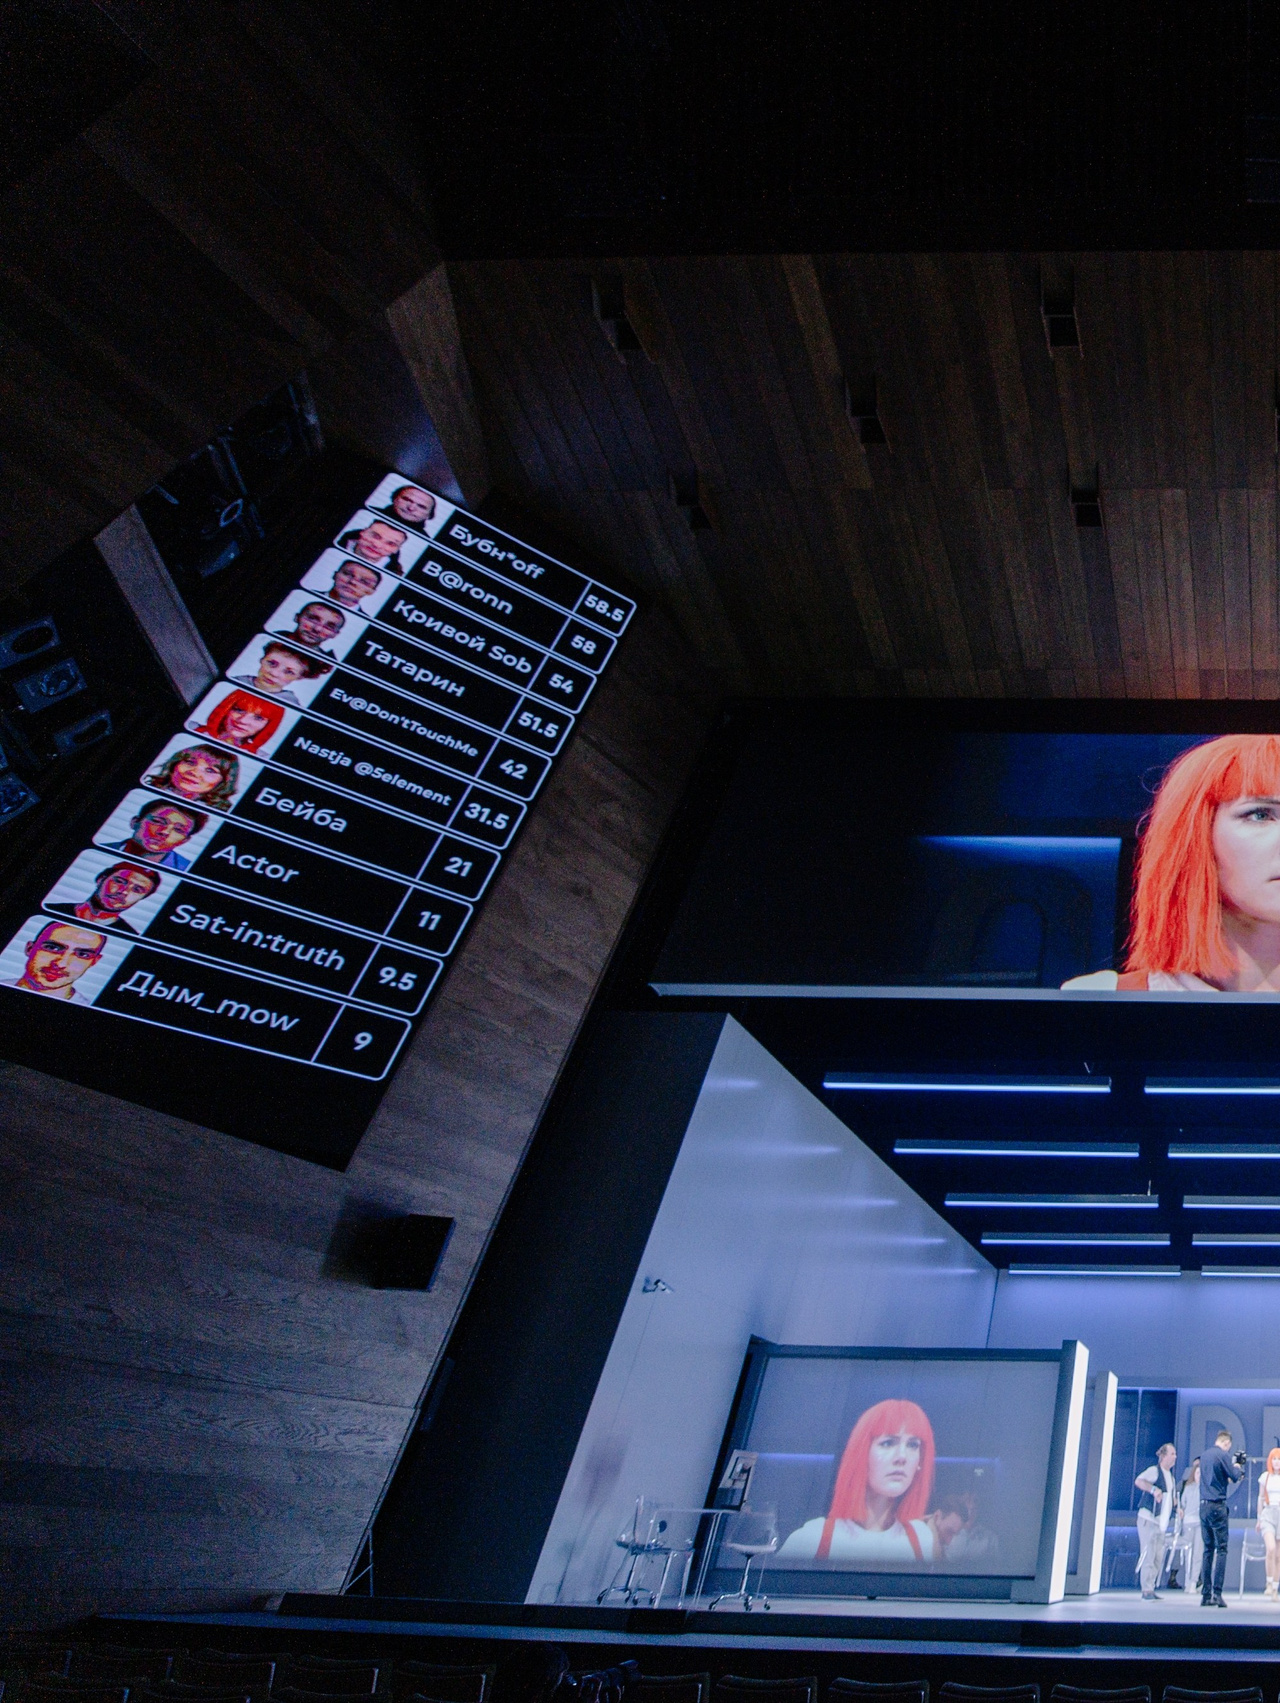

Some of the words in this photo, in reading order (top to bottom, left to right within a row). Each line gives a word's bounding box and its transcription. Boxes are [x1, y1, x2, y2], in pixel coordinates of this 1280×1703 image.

[393, 599, 486, 652] Кривой
[488, 645, 532, 673] Sob
[548, 673, 573, 694] 54
[422, 560, 513, 614] B@ronn
[571, 634, 597, 655] 58
[584, 594, 625, 622] 58.5
[365, 640, 465, 697] Татарин
[518, 711, 559, 738] 51.5
[293, 736, 352, 767] Nastja
[354, 761, 452, 806] @5element
[464, 802, 510, 830] 31.5
[499, 759, 528, 780] 42
[255, 787, 347, 833] Бейба
[444, 856, 473, 877] 21
[211, 845, 299, 882] Actor
[418, 911, 441, 931] 11
[169, 904, 345, 971] Sat-in:truth
[379, 966, 417, 991] 9.5
[117, 970, 300, 1031] Дым_mow
[353, 1032, 373, 1051] 9
